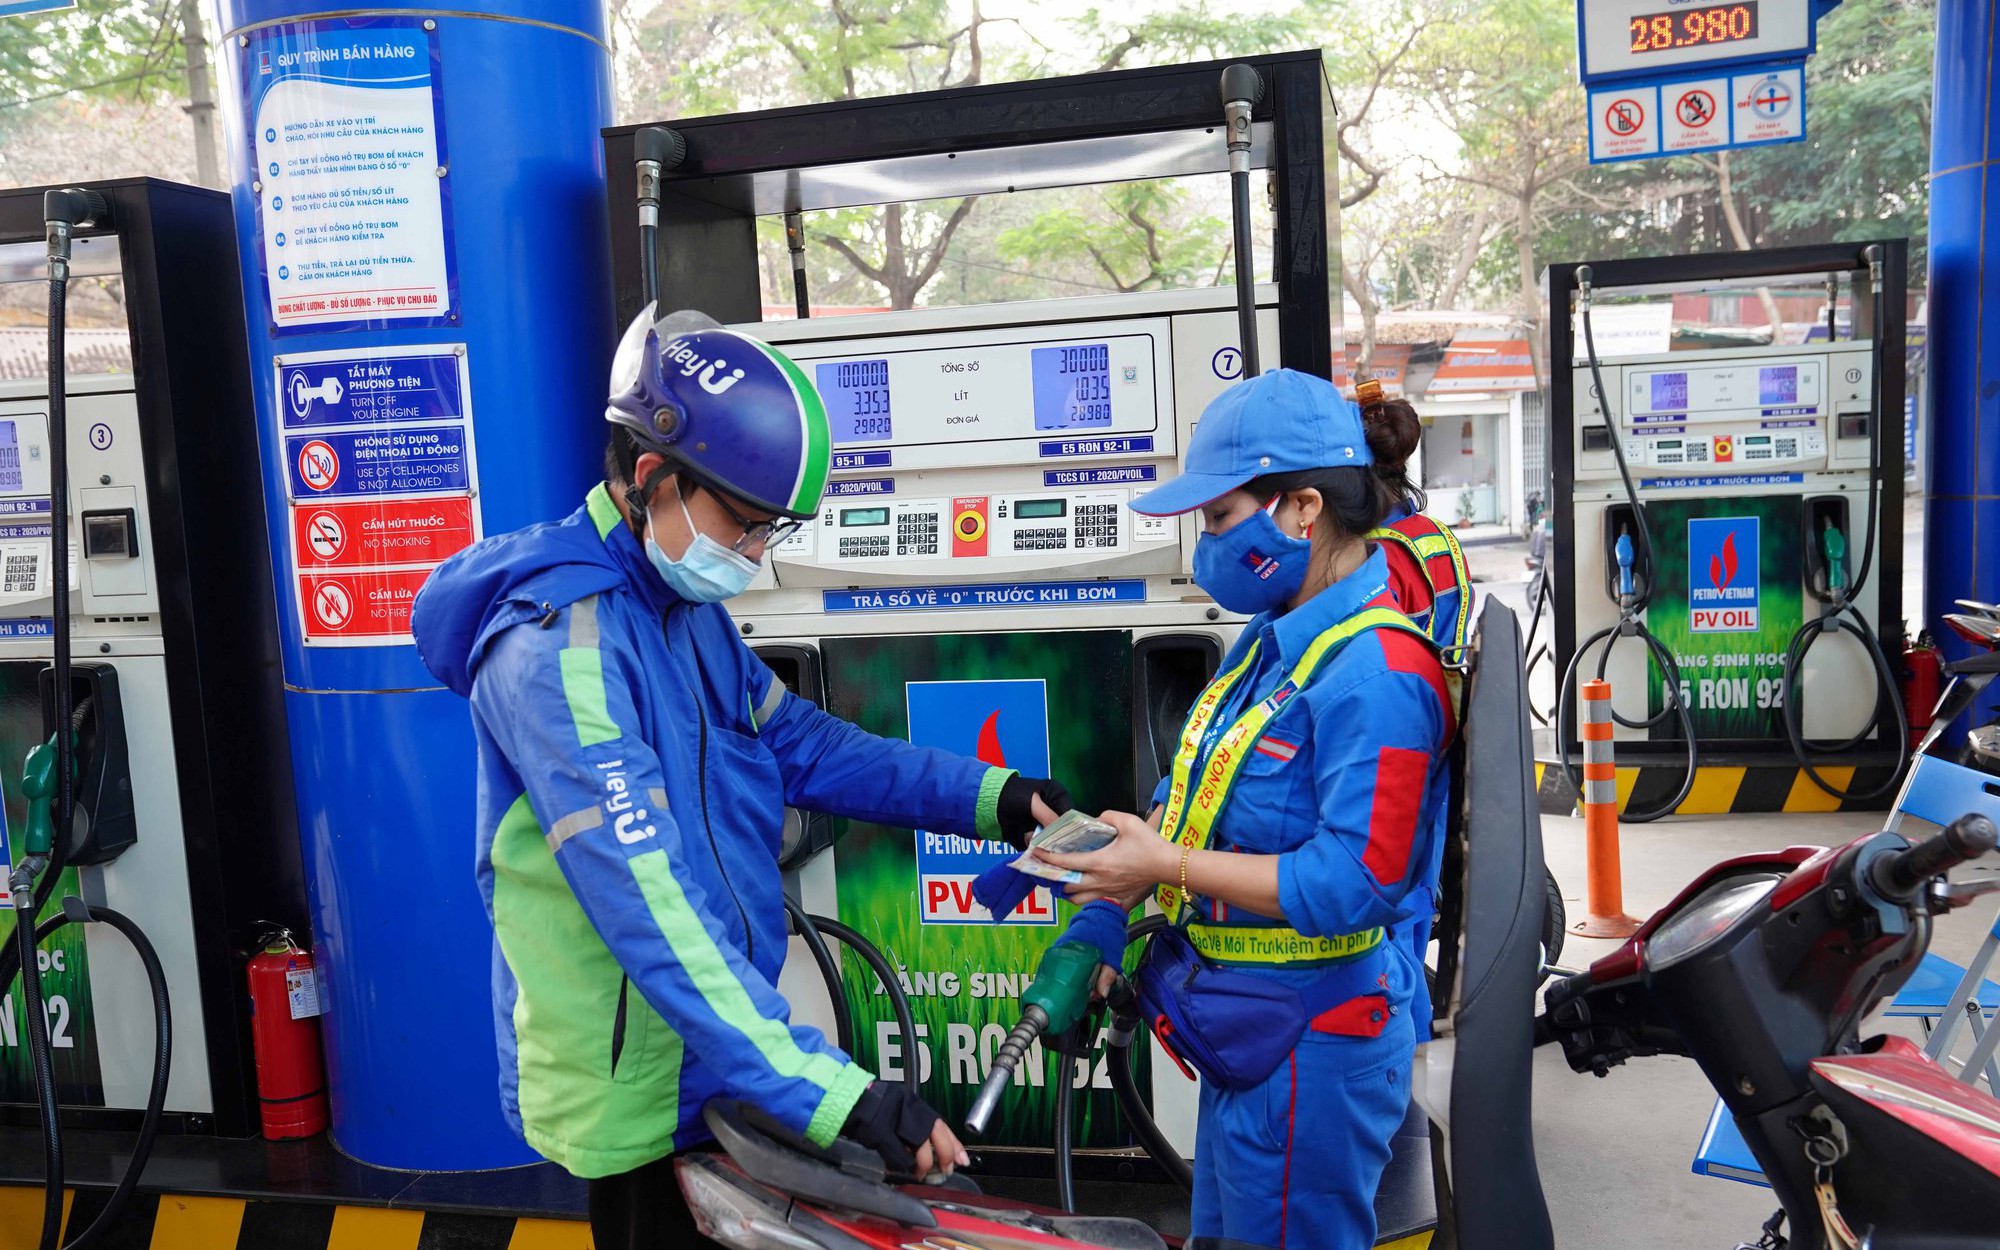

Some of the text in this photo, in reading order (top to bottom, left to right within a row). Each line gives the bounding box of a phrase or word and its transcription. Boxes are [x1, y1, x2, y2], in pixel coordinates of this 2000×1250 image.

[1630, 7, 1750, 51] 28.980
[277, 43, 415, 66] QUY TRÌNH BÁN HÀNG
[337, 117, 353, 126] VÀO
[355, 118, 362, 127] VỊ
[365, 116, 376, 124] TRÍ
[320, 125, 424, 139] NHU CẦU CỦA KHÁCH HÀNG
[397, 150, 424, 158] KHÁCH
[340, 160, 397, 172] HÌNH ĐANG SỐ
[291, 186, 394, 202] BƠM HÀNG ĐỦ SỐ LÍT
[292, 197, 409, 212] THEO CỦA KHÁCH HÀNG
[304, 236, 327, 245] KHÁCH
[330, 233, 350, 242] HÀNG
[298, 263, 310, 271] THU
[345, 260, 357, 268] LẠI
[372, 256, 389, 264] TIỀN
[326, 269, 350, 278] KHÁCH
[351, 268, 373, 277] HÀNG
[377, 297, 395, 308] PHỤC
[397, 296, 406, 307] VỤ
[408, 295, 422, 304] CHU
[941, 359, 980, 374] TỔNG SỐ
[1060, 347, 1108, 374] 30000
[1223, 354, 1233, 372] 7
[348, 363, 391, 378] TẮT MÁY
[838, 362, 888, 388] 100000
[350, 376, 421, 390] PHƯƠNG TIỆN
[350, 396, 396, 408] TURN OFF
[954, 390, 969, 402] LÍT
[352, 407, 420, 420] YOUR ENGINE
[1071, 404, 1110, 422] 28980
[854, 417, 891, 435] 29820
[97, 429, 105, 444] 3
[354, 433, 439, 447] KHÔNG SỬ DỤNG
[355, 443, 459, 460] ĐIỆN THOẠI DI ĐỘNG
[1062, 440, 1131, 454] E5 RON 92-II
[836, 455, 865, 466] 95-III
[357, 463, 459, 478] USE OF CELLPHONES
[1056, 469, 1144, 483] TCCS 01 2020/PVOIL
[358, 477, 441, 490] IS NOT ALLOWED
[840, 481, 883, 493] 2020/PVOIL
[16, 502, 37, 512] 92-II
[362, 514, 445, 531] CẤM HÚT THUỐC
[9, 528, 17, 537] 02
[364, 536, 431, 549] NO SMOKING
[369, 586, 413, 600] CẤM LỬA
[852, 586, 1117, 607] TRẢ SỐ VỀ TRƯỚC KHI BƠM
[1693, 587, 1754, 600] PETROVIETNAM
[371, 608, 408, 618] NO FIRE
[1694, 611, 1754, 627] PV OIL
[18, 623, 47, 635] BƠM
[1713, 653, 1787, 670] SINH HỌC
[1700, 678, 1749, 709] RON
[1757, 678, 1784, 708] 92
[1190, 694, 1216, 731] RON
[1207, 747, 1231, 790] RON
[1173, 782, 1184, 805] E5
[1198, 787, 1214, 810] 92
[1183, 825, 1200, 850] E5
[1160, 887, 1175, 908] 92
[1225, 935, 1245, 954] Môi
[1275, 936, 1314, 959] kiệm
